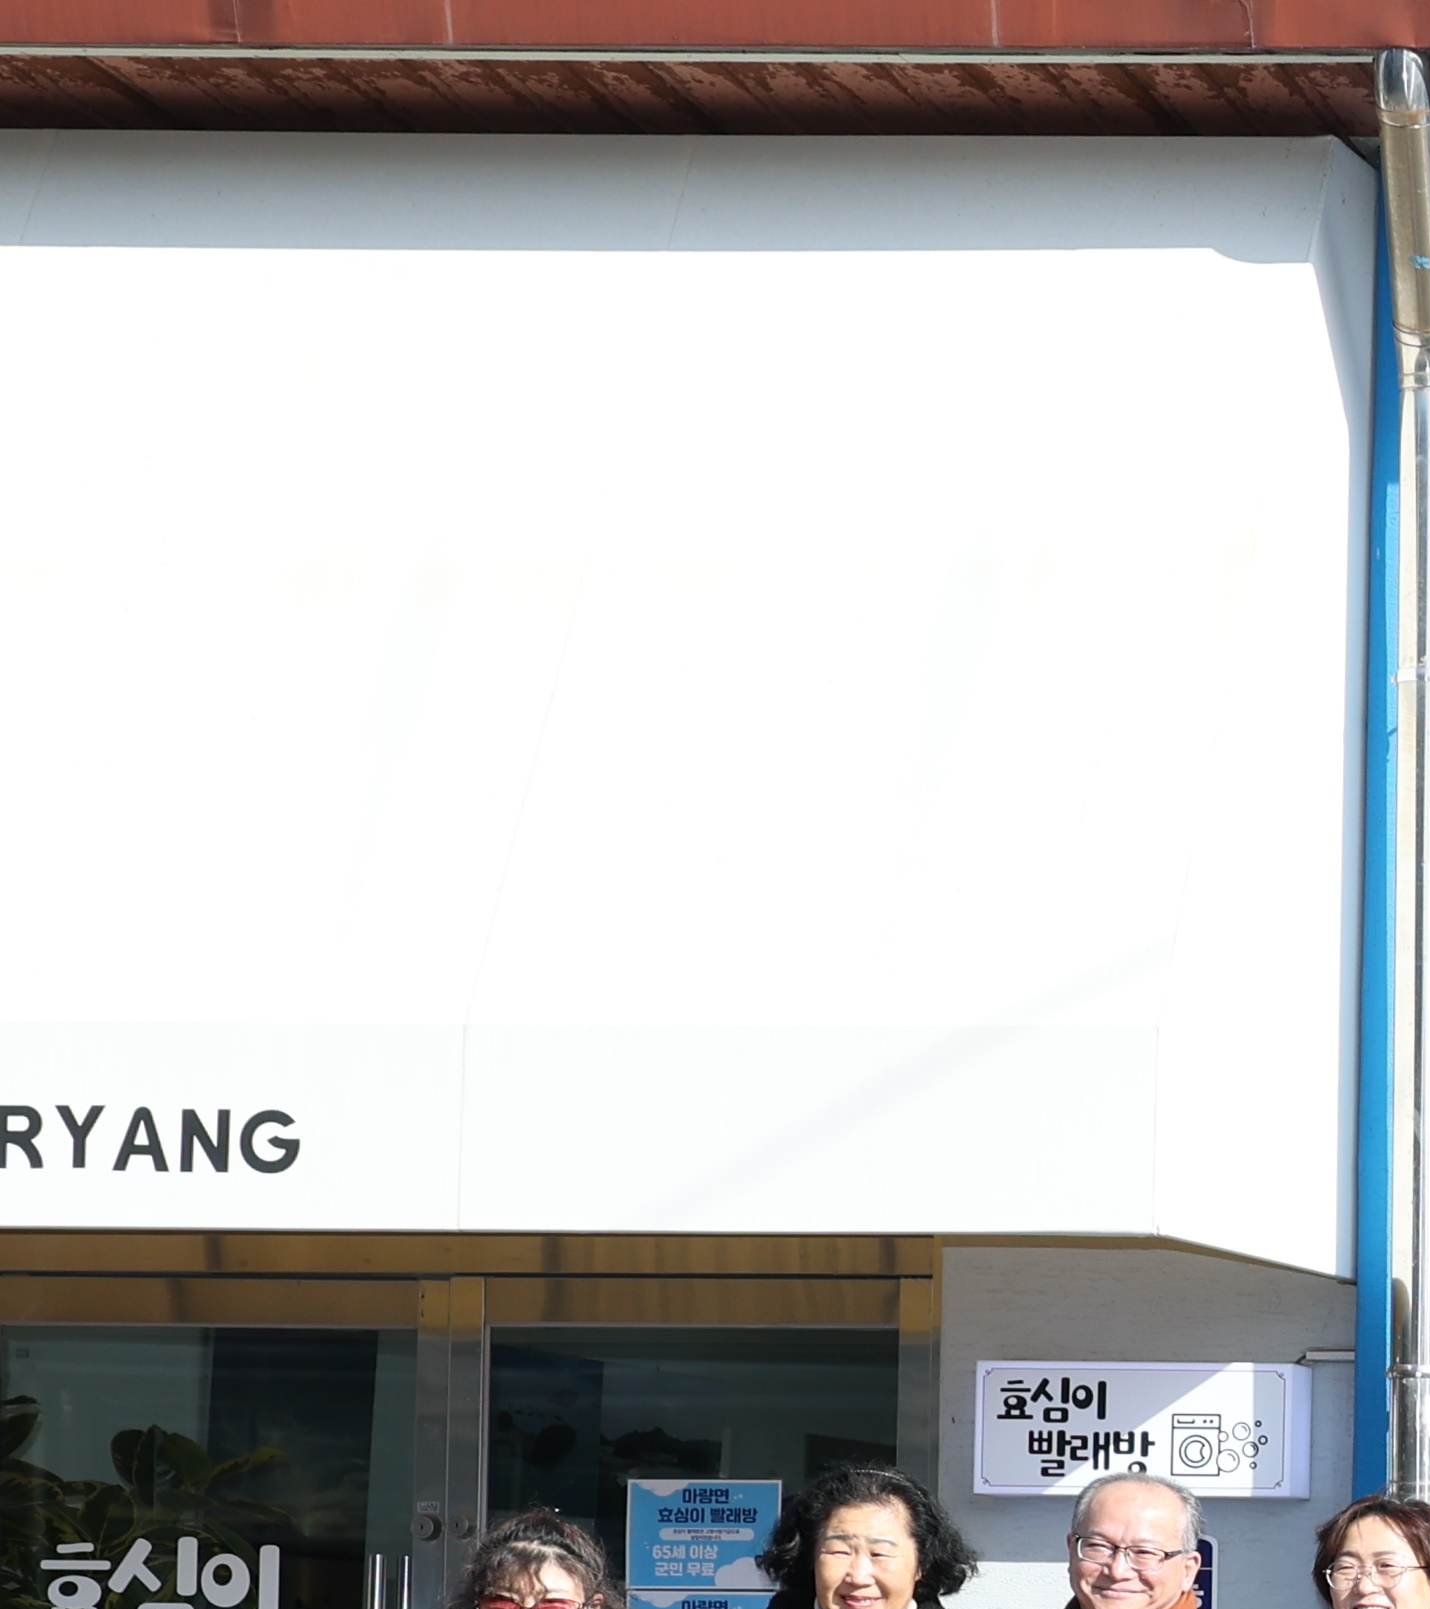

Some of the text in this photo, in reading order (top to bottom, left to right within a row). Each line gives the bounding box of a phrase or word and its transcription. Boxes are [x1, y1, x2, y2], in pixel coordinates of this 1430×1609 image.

[0, 1104, 301, 1175] RYANG
[996, 1376, 1108, 1423] 효심이
[1027, 1429, 1156, 1477] 빨래방
[681, 1487, 730, 1505] 마량면
[657, 1507, 758, 1524] 효심이 빨래방
[652, 1545, 719, 1560] 65세 이상
[654, 1562, 716, 1577] 군민 무료
